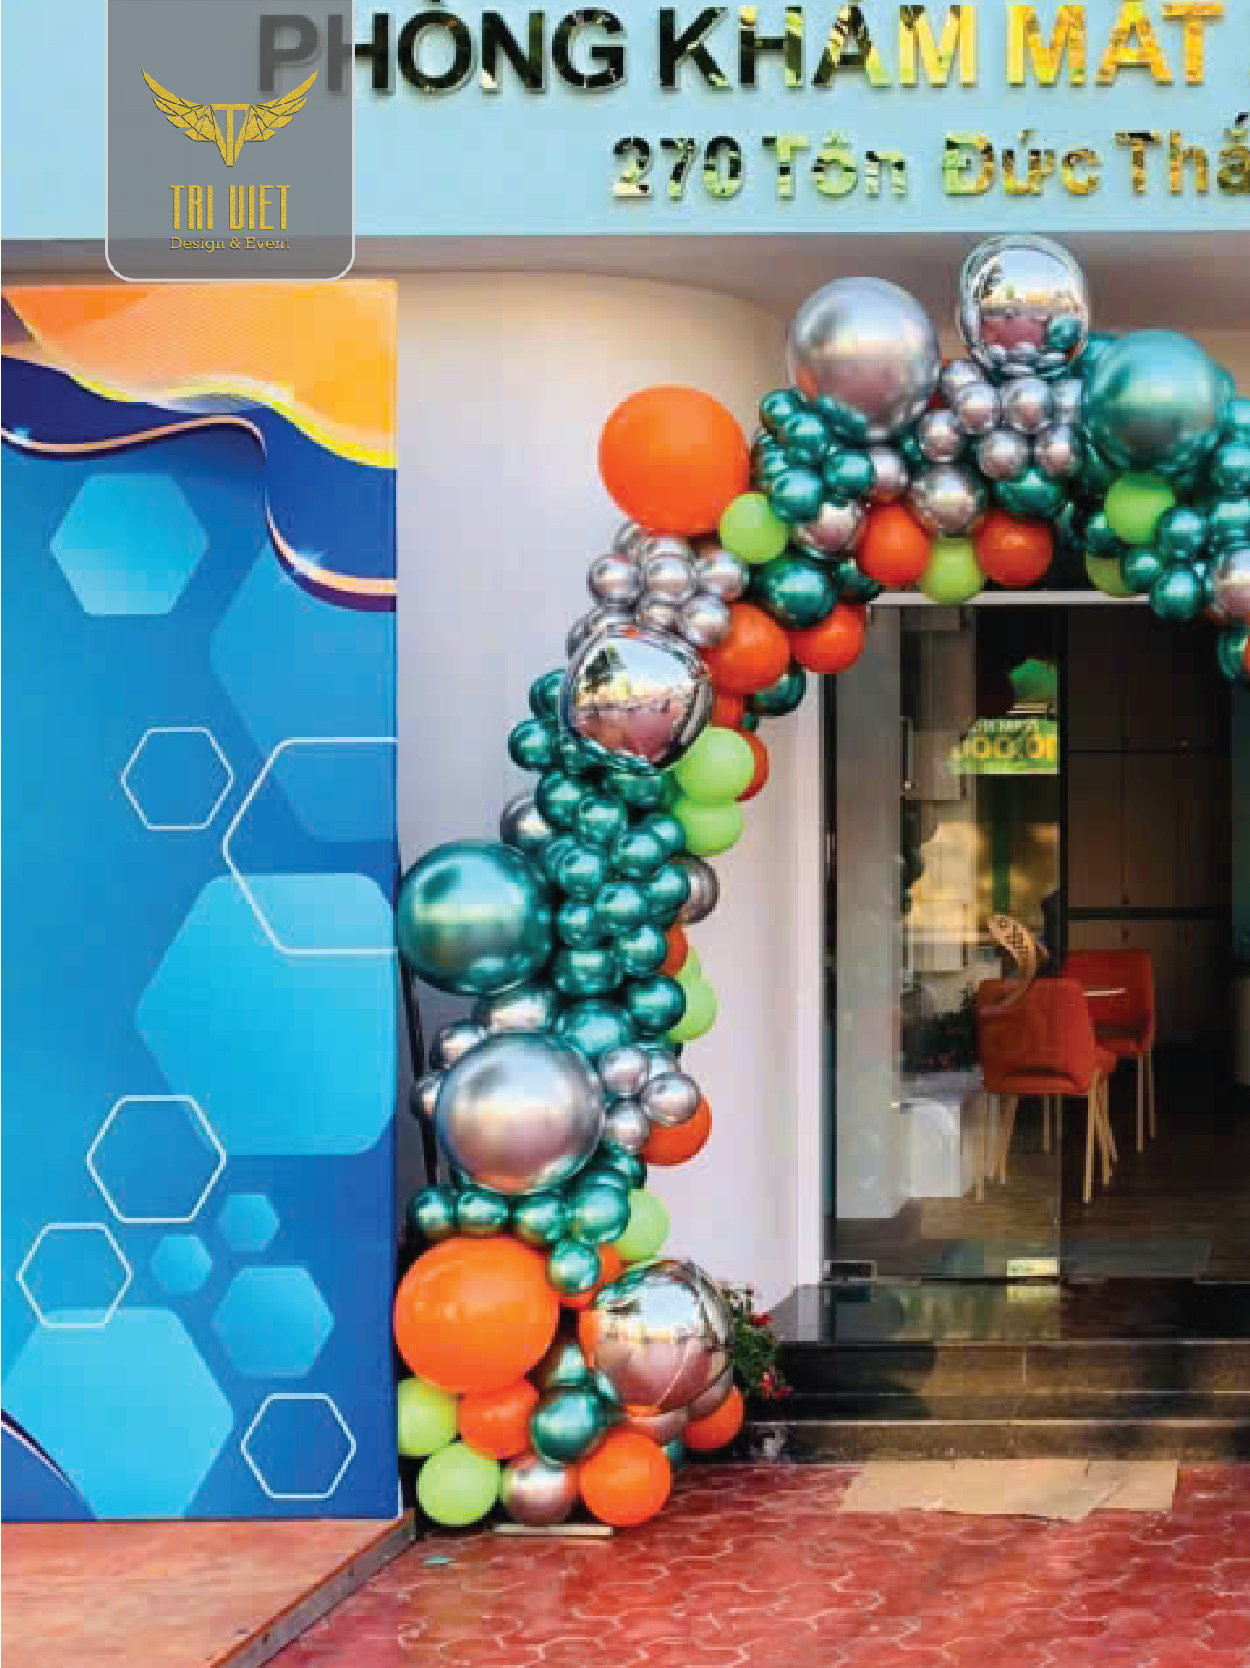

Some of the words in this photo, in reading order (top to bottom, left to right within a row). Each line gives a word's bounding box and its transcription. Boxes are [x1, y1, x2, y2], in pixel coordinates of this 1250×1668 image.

[612, 135, 743, 199] 270
[761, 130, 907, 199] Tôn
[942, 128, 1101, 196] Đức
